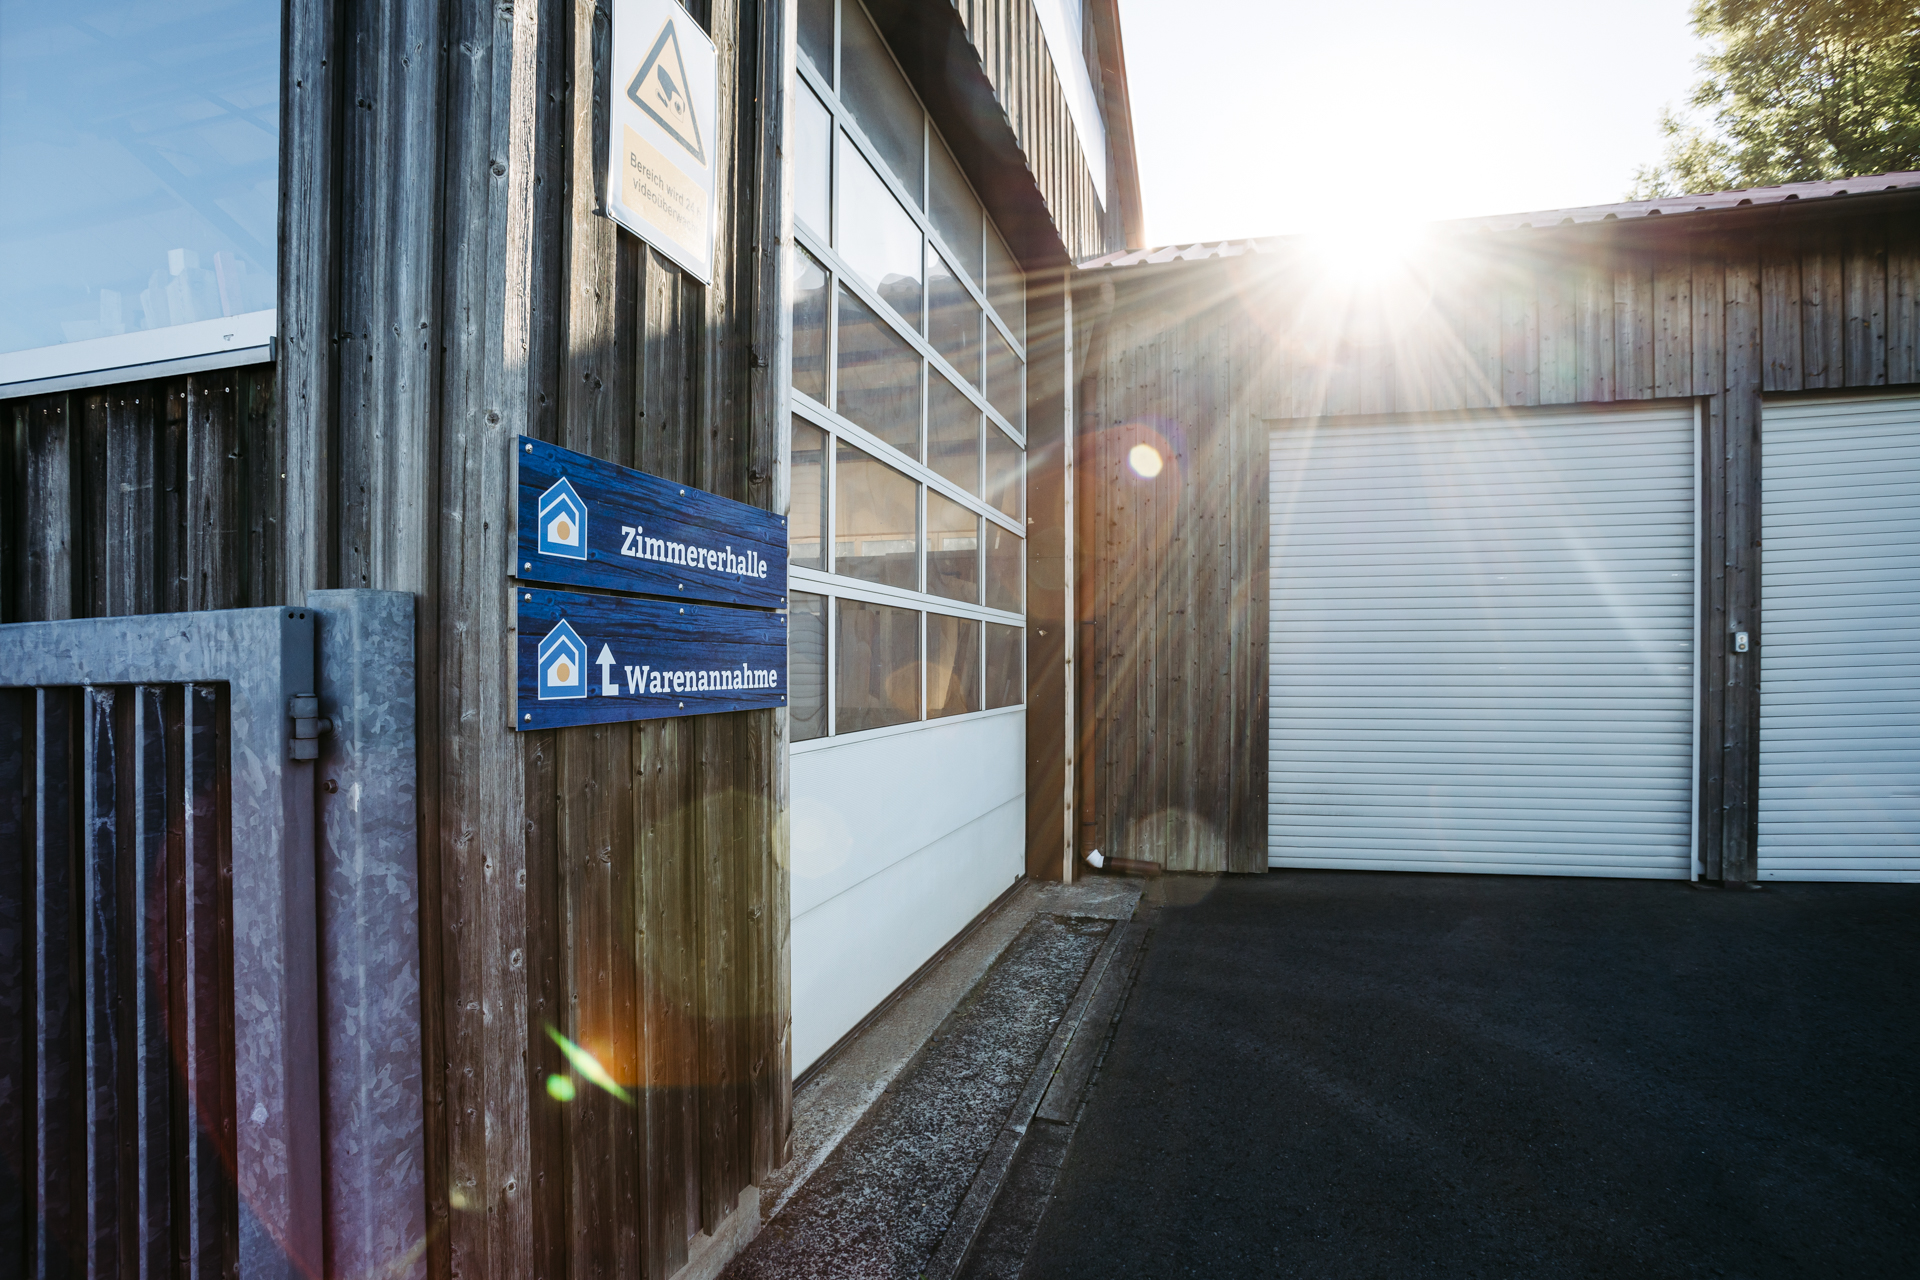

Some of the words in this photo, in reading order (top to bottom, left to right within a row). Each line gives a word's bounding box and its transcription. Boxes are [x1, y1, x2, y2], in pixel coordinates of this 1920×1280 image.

[630, 151, 664, 191] Bereich
[666, 184, 684, 207] wird
[620, 525, 768, 579] Zimmererhalle
[624, 662, 778, 694] Warenannahme
